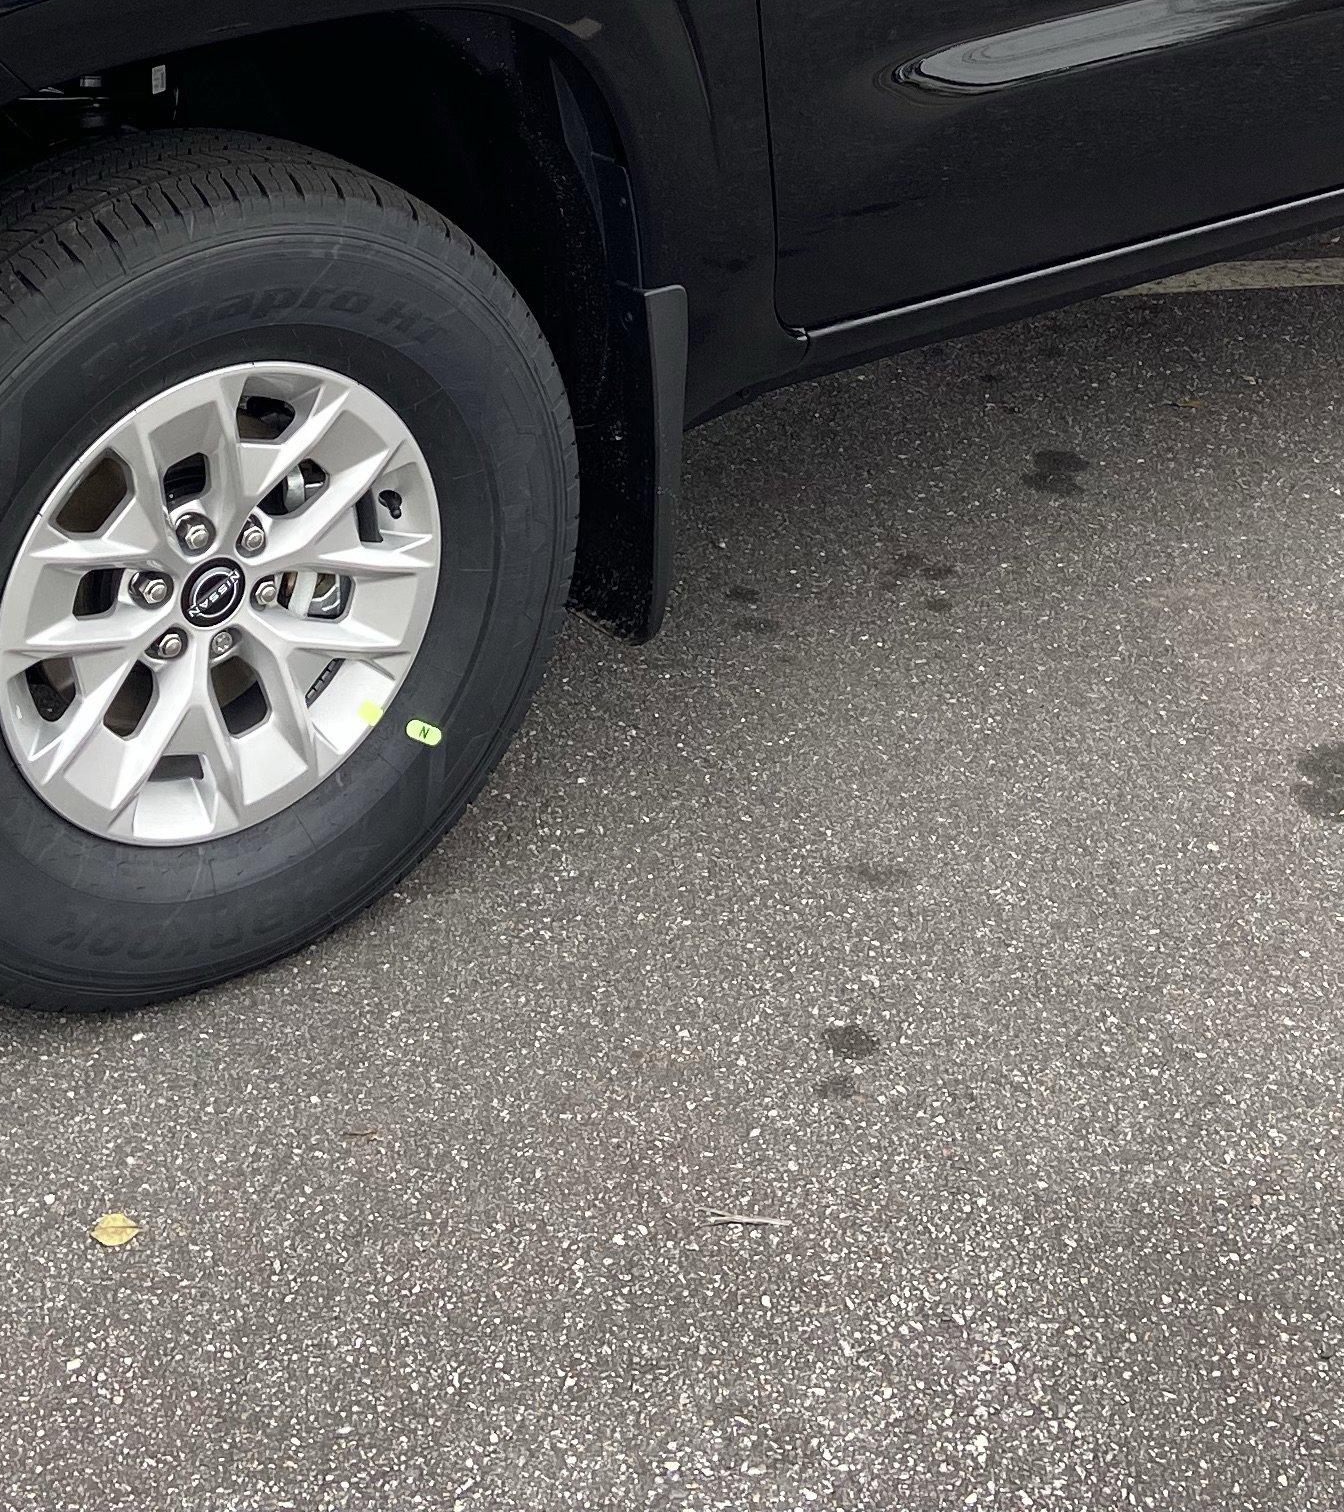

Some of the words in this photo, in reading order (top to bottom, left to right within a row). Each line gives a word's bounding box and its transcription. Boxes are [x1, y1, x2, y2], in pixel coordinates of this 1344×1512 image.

[80, 286, 374, 381] napro
[188, 569, 240, 618] NISSAN
[419, 725, 431, 739] N
